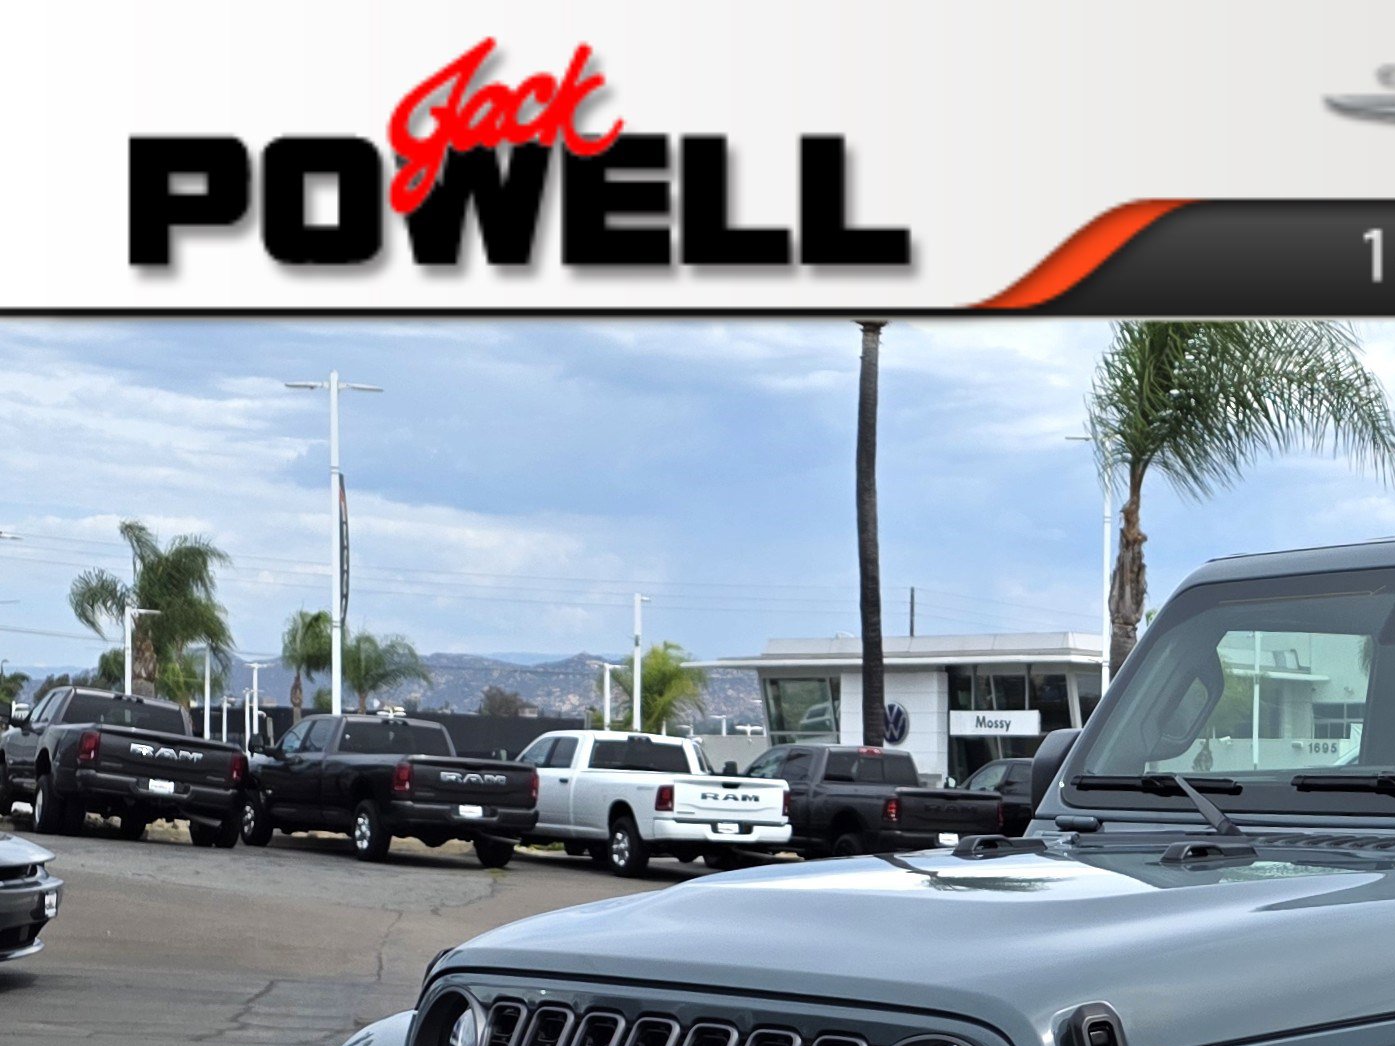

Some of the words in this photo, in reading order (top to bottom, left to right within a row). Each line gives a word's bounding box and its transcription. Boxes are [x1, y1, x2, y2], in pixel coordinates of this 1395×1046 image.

[975, 715, 1011, 732] Mossy
[130, 742, 204, 764] RAM
[440, 771, 507, 785] RAM
[701, 792, 760, 803] RAM
